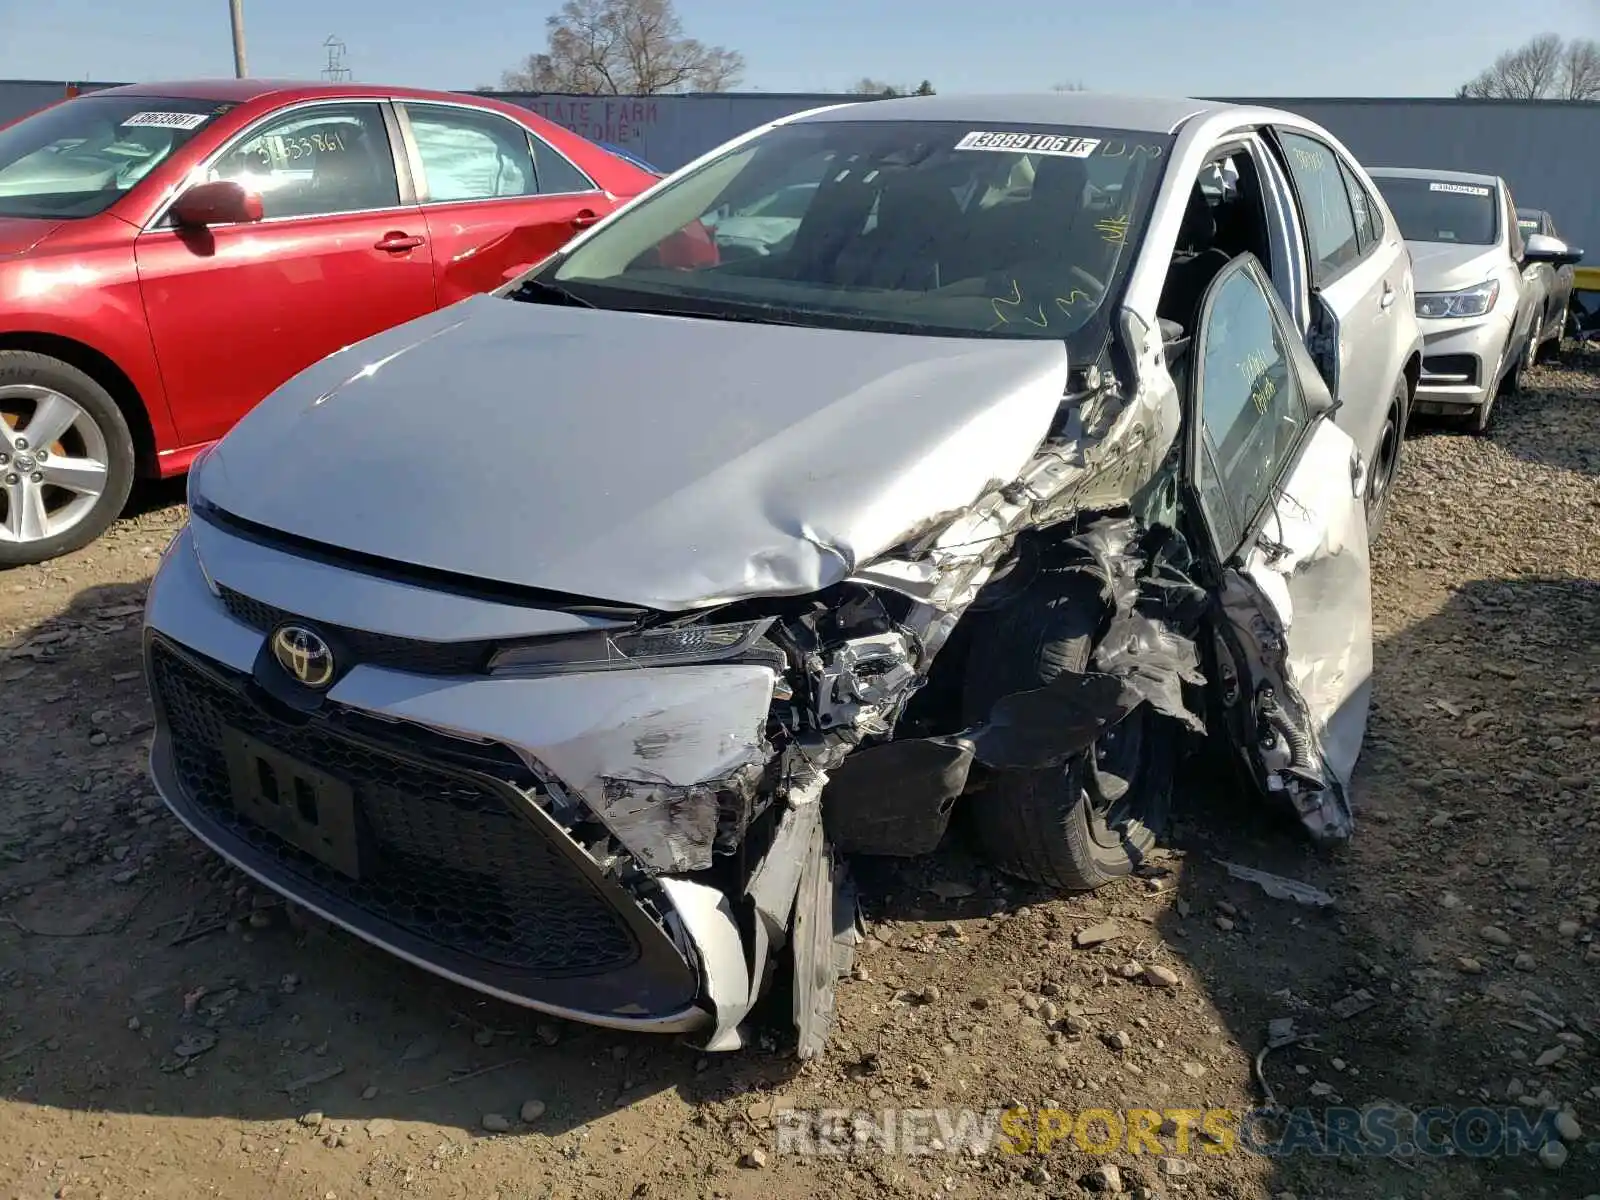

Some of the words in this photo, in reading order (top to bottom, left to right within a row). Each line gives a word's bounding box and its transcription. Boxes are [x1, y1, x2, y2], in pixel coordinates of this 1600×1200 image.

[528, 102, 592, 122] STATE
[604, 102, 657, 123] FARM
[976, 132, 1077, 153] 38891061
